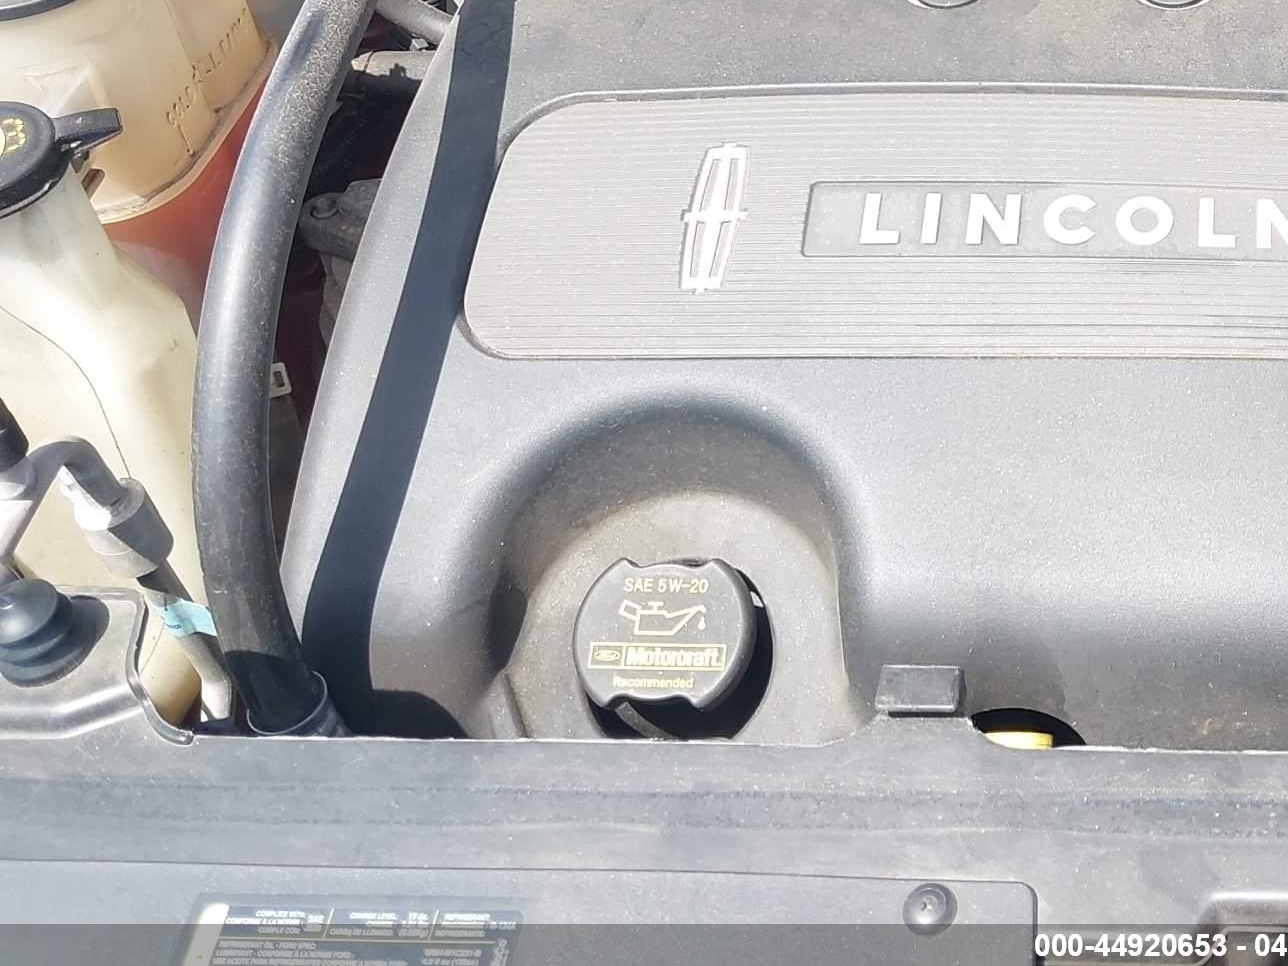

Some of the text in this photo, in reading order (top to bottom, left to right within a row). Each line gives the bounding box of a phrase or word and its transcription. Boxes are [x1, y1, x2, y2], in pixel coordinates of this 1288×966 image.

[624, 577, 709, 594] SAE 5W-20
[613, 676, 695, 689] Recommended
